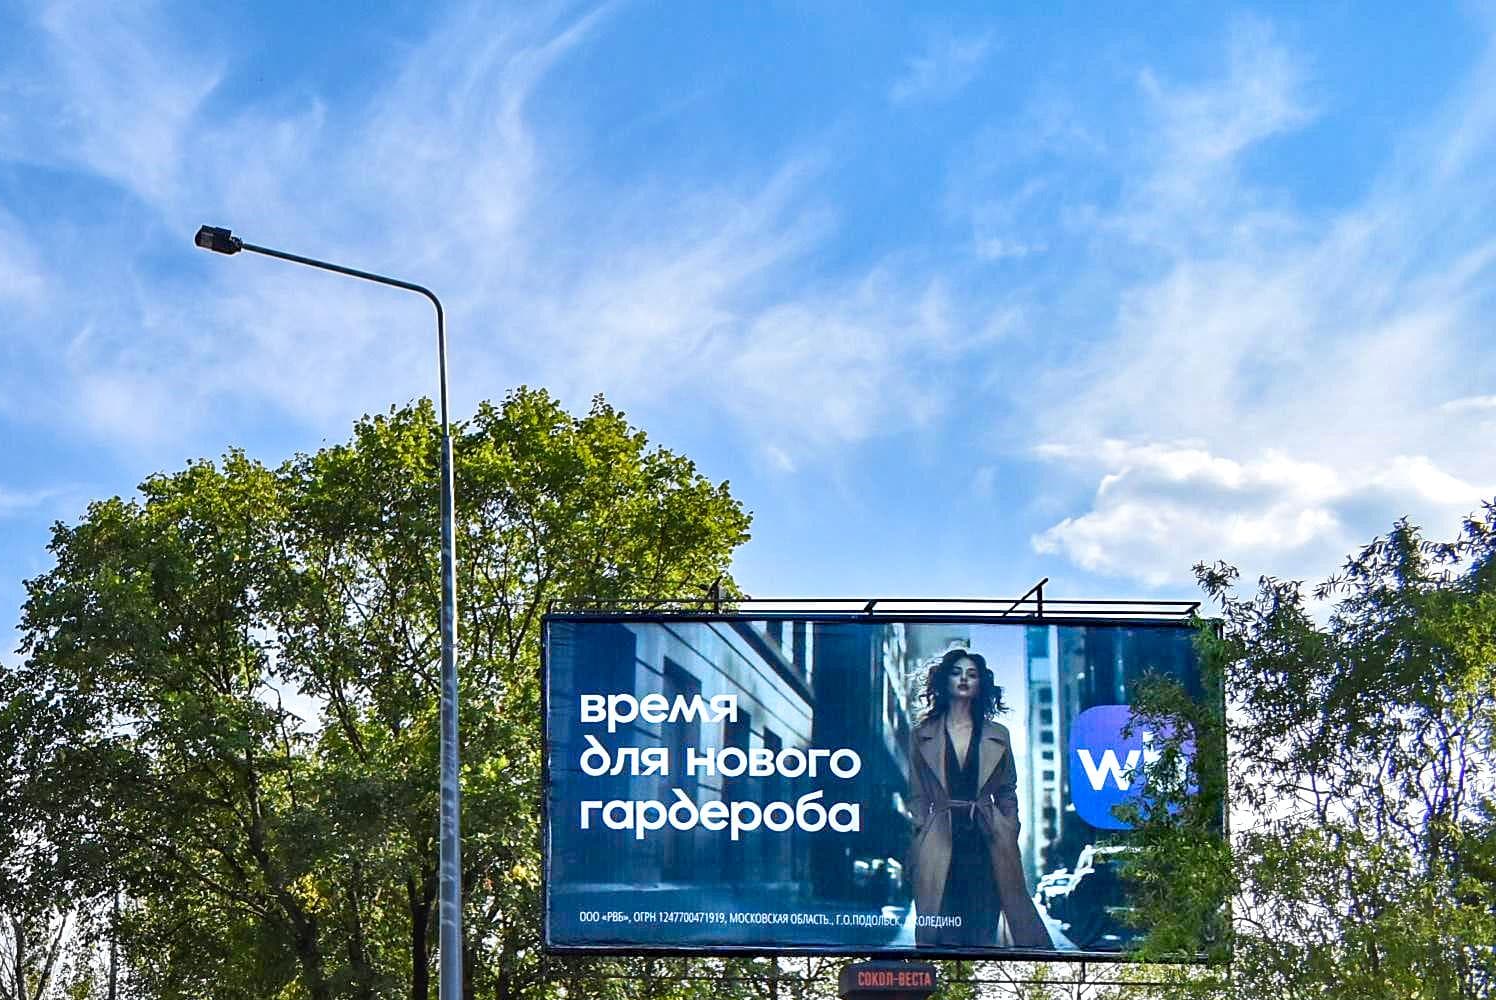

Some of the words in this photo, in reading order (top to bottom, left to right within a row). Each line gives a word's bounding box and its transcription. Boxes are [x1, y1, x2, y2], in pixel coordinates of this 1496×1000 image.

[580, 694, 738, 733] время
[579, 735, 669, 777] для
[687, 747, 862, 779] нового
[580, 788, 860, 841] гардероба
[579, 911, 600, 923] ООО
[633, 911, 656, 923] ОГРН
[659, 911, 728, 925] 1247700471919,
[729, 912, 789, 925] МОСКОВСКАЯ
[857, 971, 932, 987] СОКОЛ-ВЕСТА
